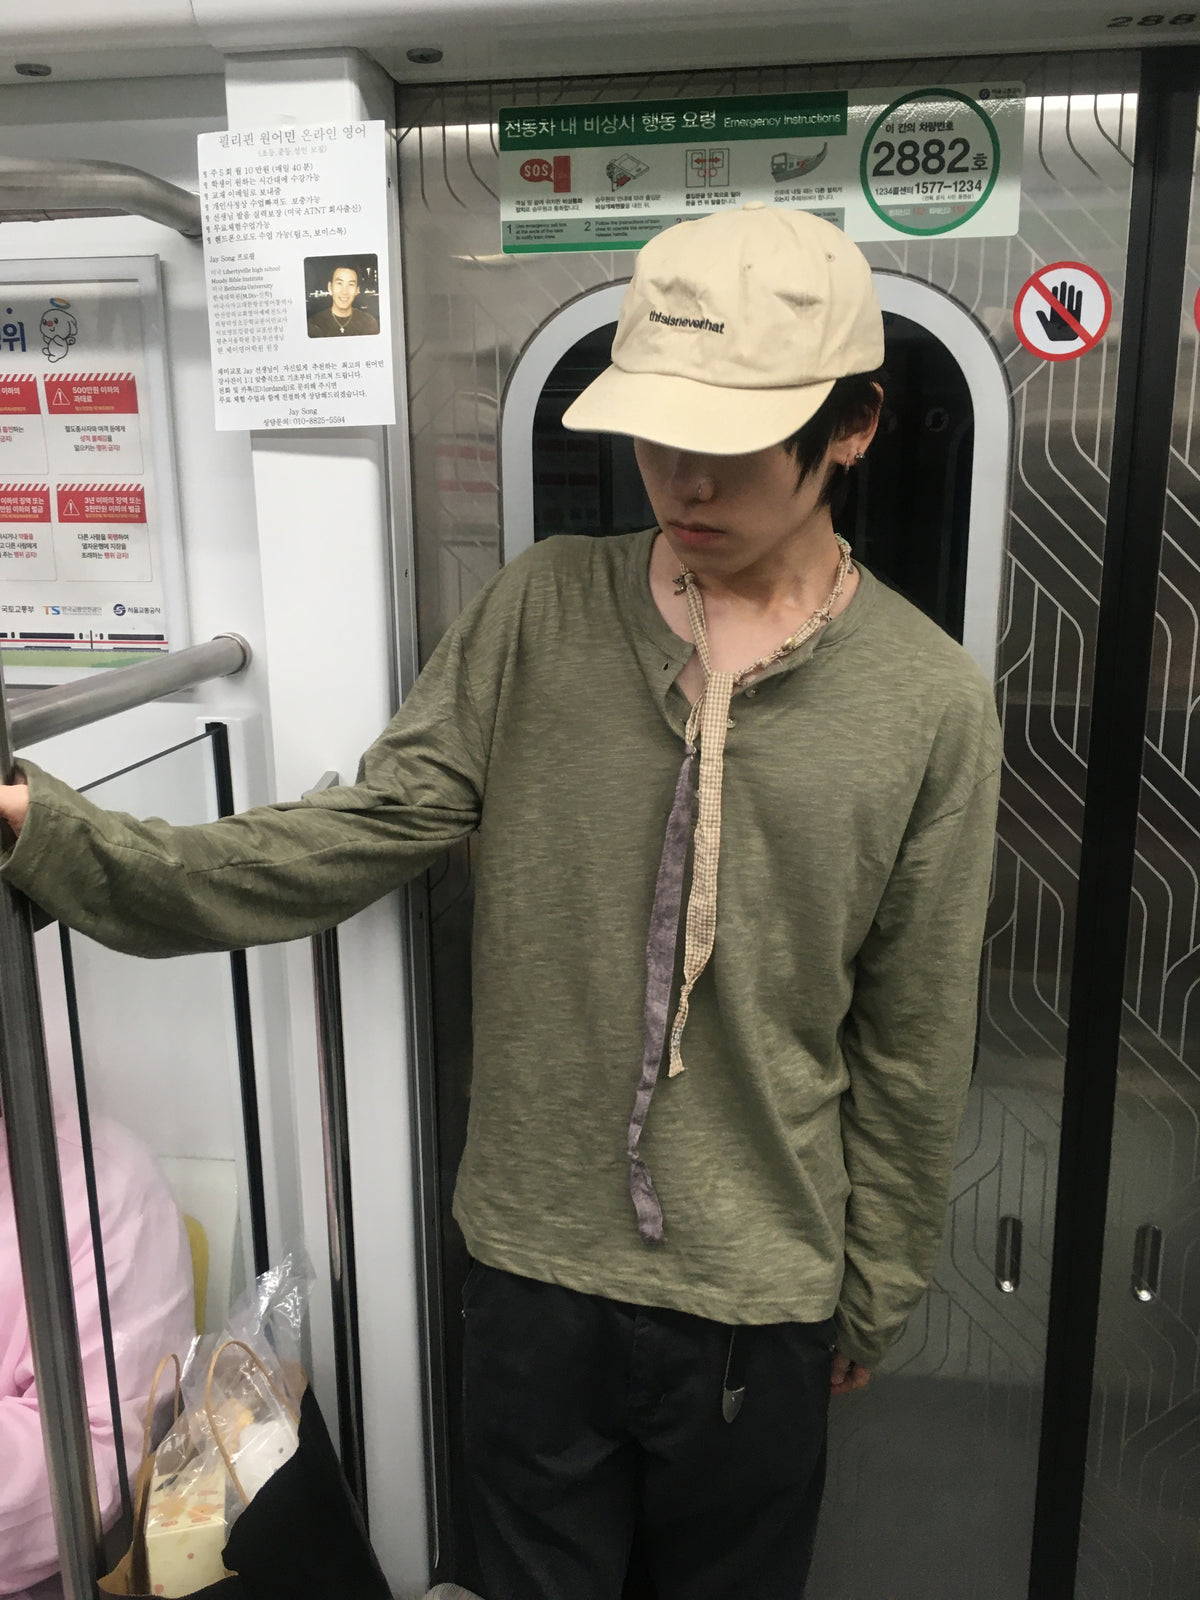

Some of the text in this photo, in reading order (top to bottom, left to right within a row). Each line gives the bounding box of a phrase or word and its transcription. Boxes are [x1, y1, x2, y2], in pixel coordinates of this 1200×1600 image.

[505, 109, 841, 138] 전동차 내 비상시 행동 요령 Emergency Instructions
[885, 123, 895, 133] 이
[898, 122, 916, 133] 칸의
[219, 124, 366, 148] 필리핀 원어민 온라인 영어
[873, 137, 988, 177] 2882 호
[524, 164, 549, 177] SOS
[875, 179, 982, 195] 1234콜센터 1577-1234
[304, 206, 326, 215] ATNT
[507, 224, 512, 234] 1
[584, 221, 591, 232] 2
[289, 407, 318, 416] Jay Song
[1, 605, 34, 613] 국토교통부
[42, 605, 60, 615] TS
[127, 606, 161, 614] 서울교통공사
